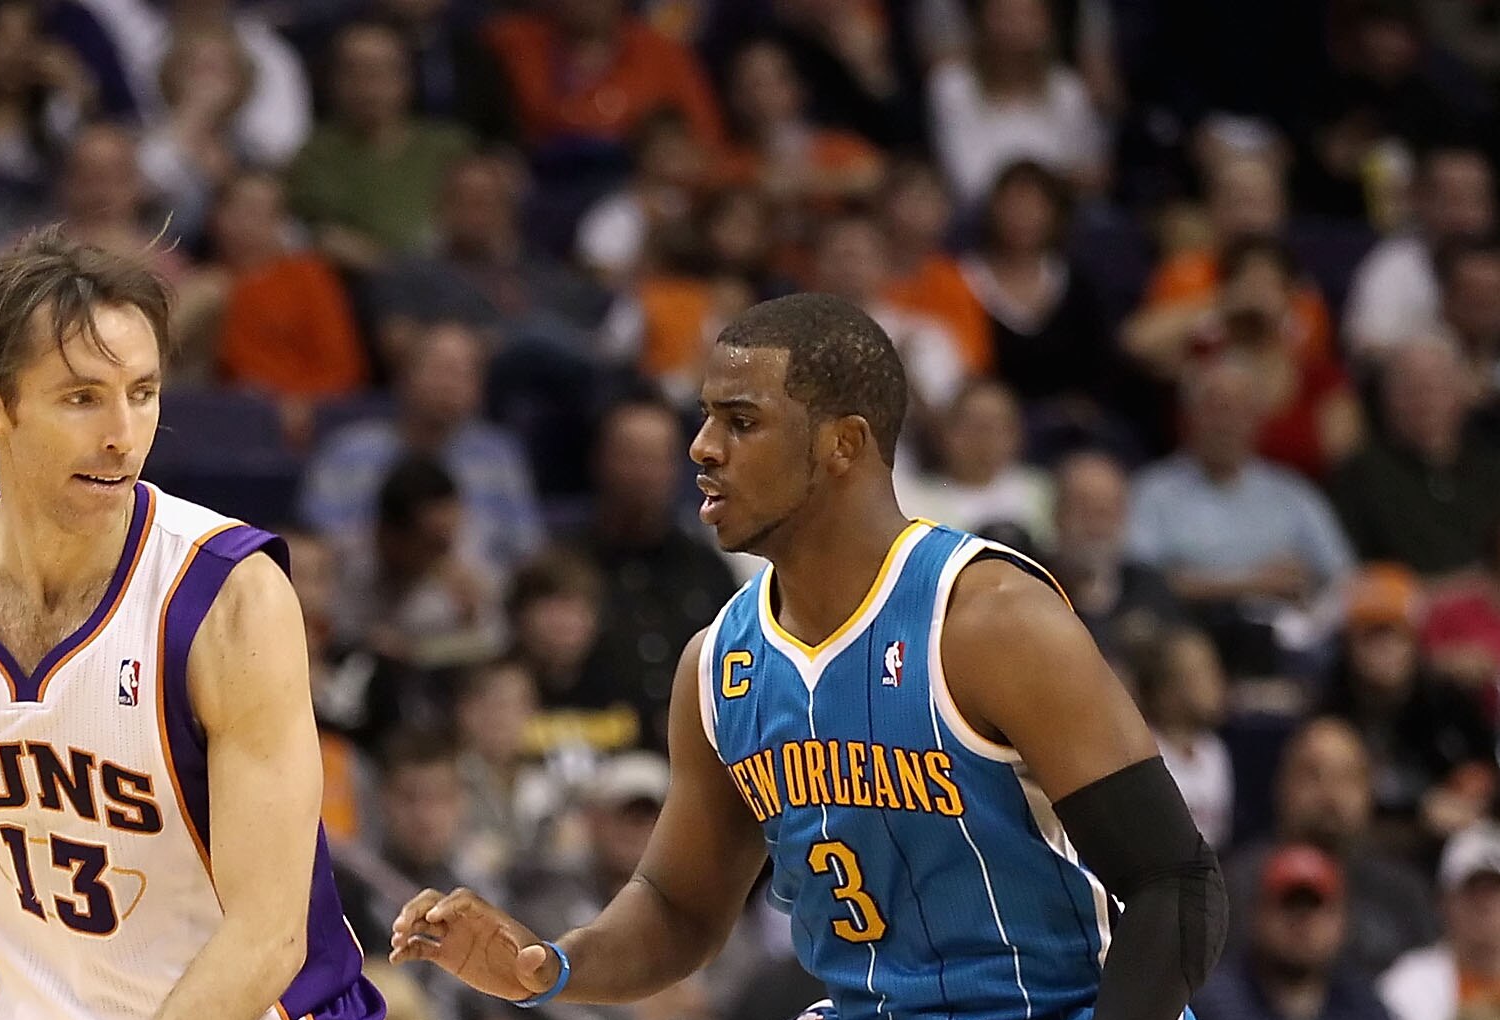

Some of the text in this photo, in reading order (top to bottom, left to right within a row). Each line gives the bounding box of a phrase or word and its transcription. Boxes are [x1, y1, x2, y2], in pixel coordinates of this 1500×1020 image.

[721, 650, 752, 698] C
[727, 739, 966, 823] EW ORLEANS
[807, 840, 887, 944] 3
